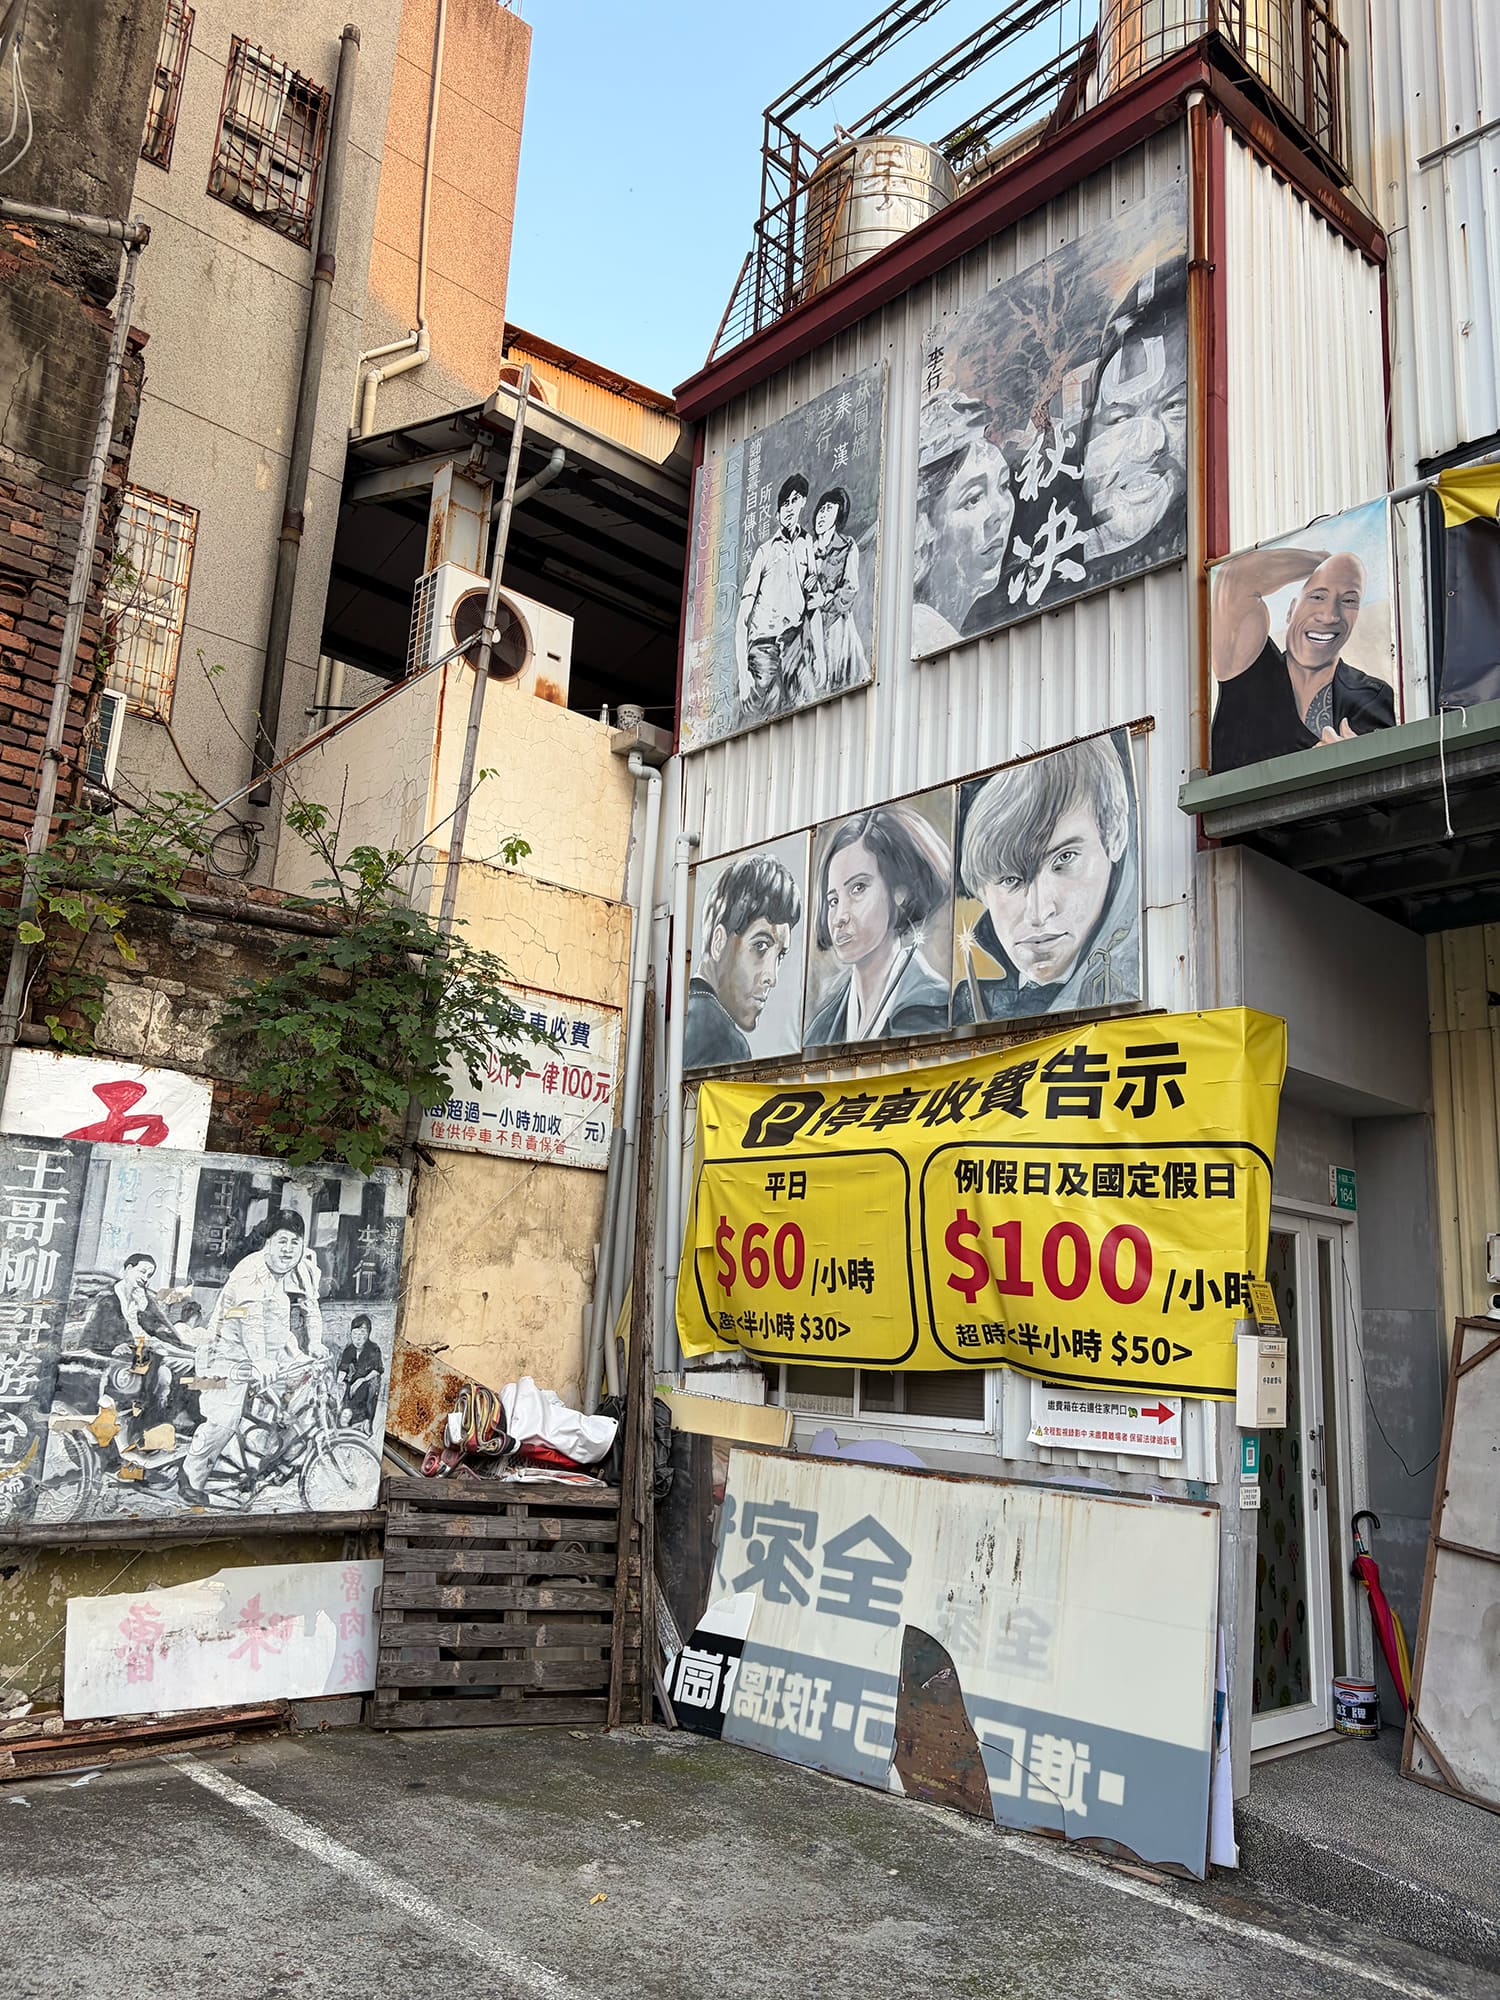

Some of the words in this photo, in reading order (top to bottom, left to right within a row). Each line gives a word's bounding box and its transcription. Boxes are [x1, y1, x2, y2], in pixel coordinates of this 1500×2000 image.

[927, 346, 944, 392] 李行
[1007, 418, 1089, 605] 秋決
[806, 1041, 1187, 1136] 停車收費告示
[765, 1171, 807, 1200] 平日
[954, 1159, 1235, 1199] 例假日及國定假日
[1340, 1188, 1353, 1203] 164
